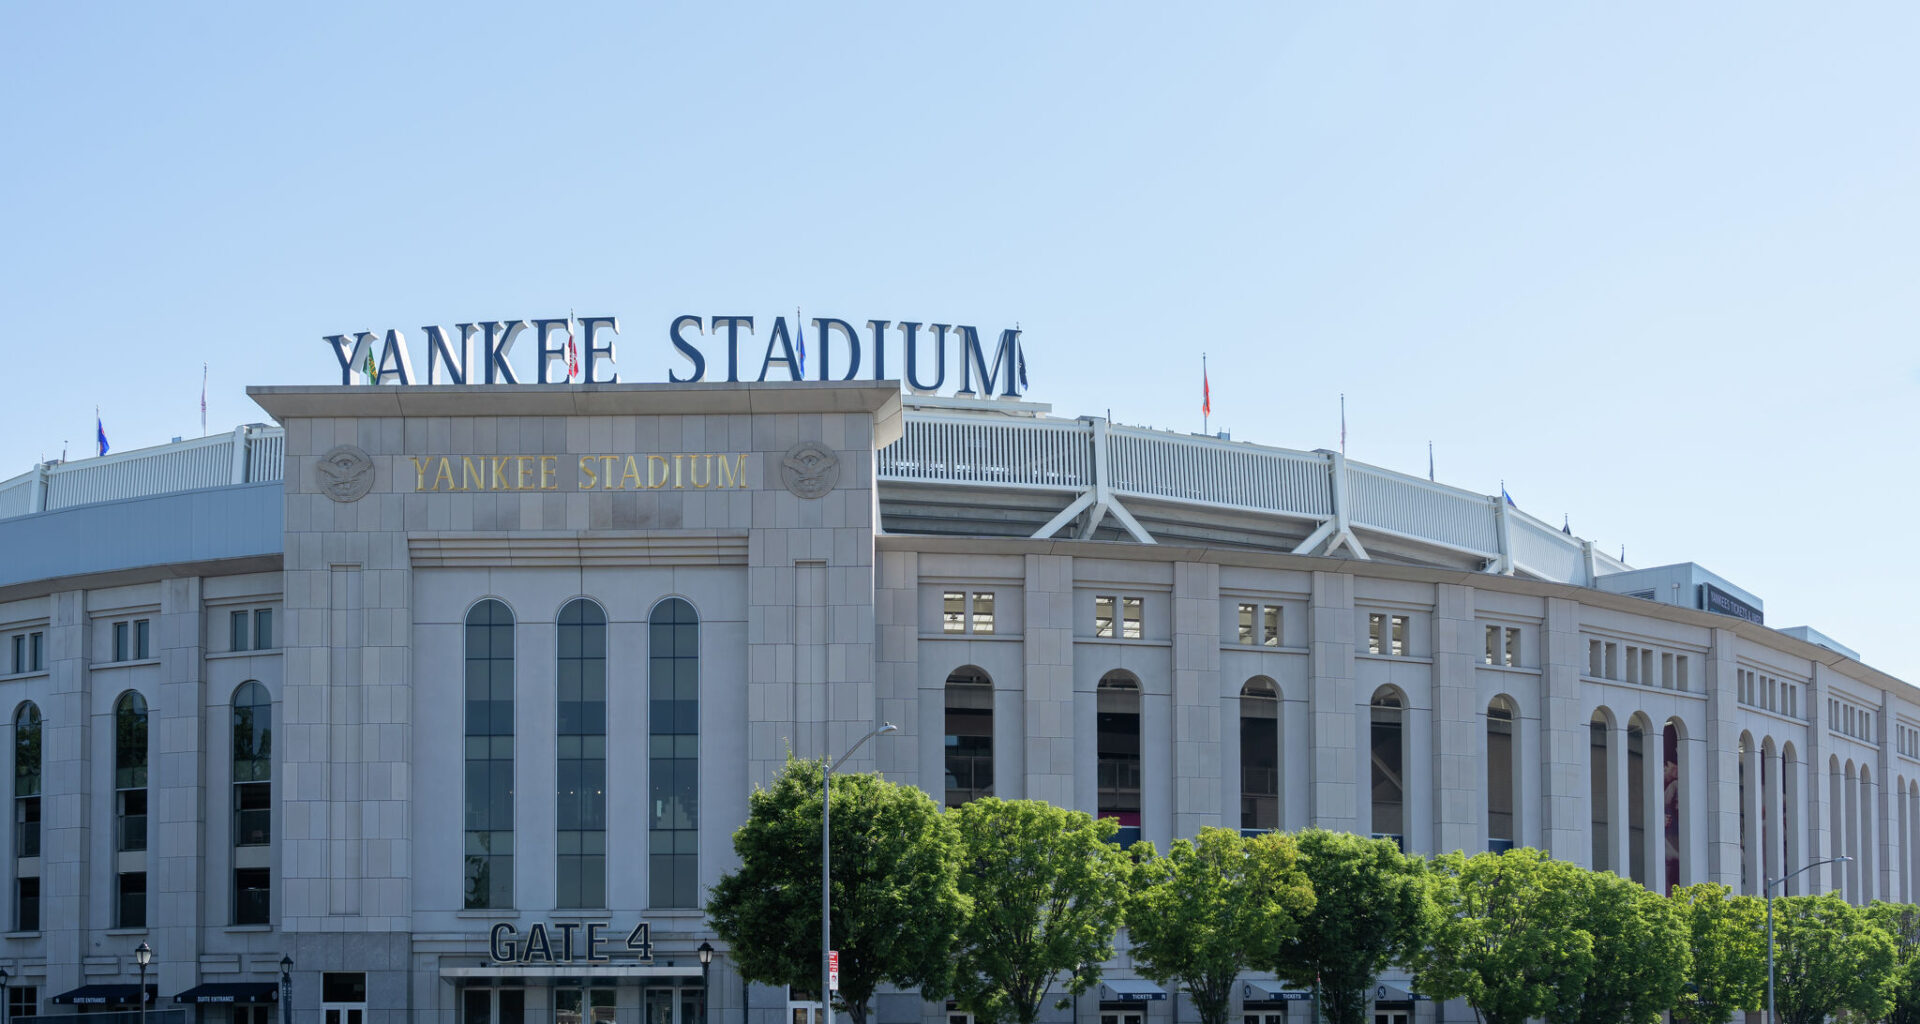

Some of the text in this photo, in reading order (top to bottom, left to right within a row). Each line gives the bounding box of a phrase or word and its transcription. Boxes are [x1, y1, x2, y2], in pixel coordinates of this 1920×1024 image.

[322, 316, 620, 385] YANKEE
[669, 314, 1023, 399] STADIUM
[411, 454, 749, 491] YANKEE STADIUM
[489, 921, 654, 963] GATE 4
